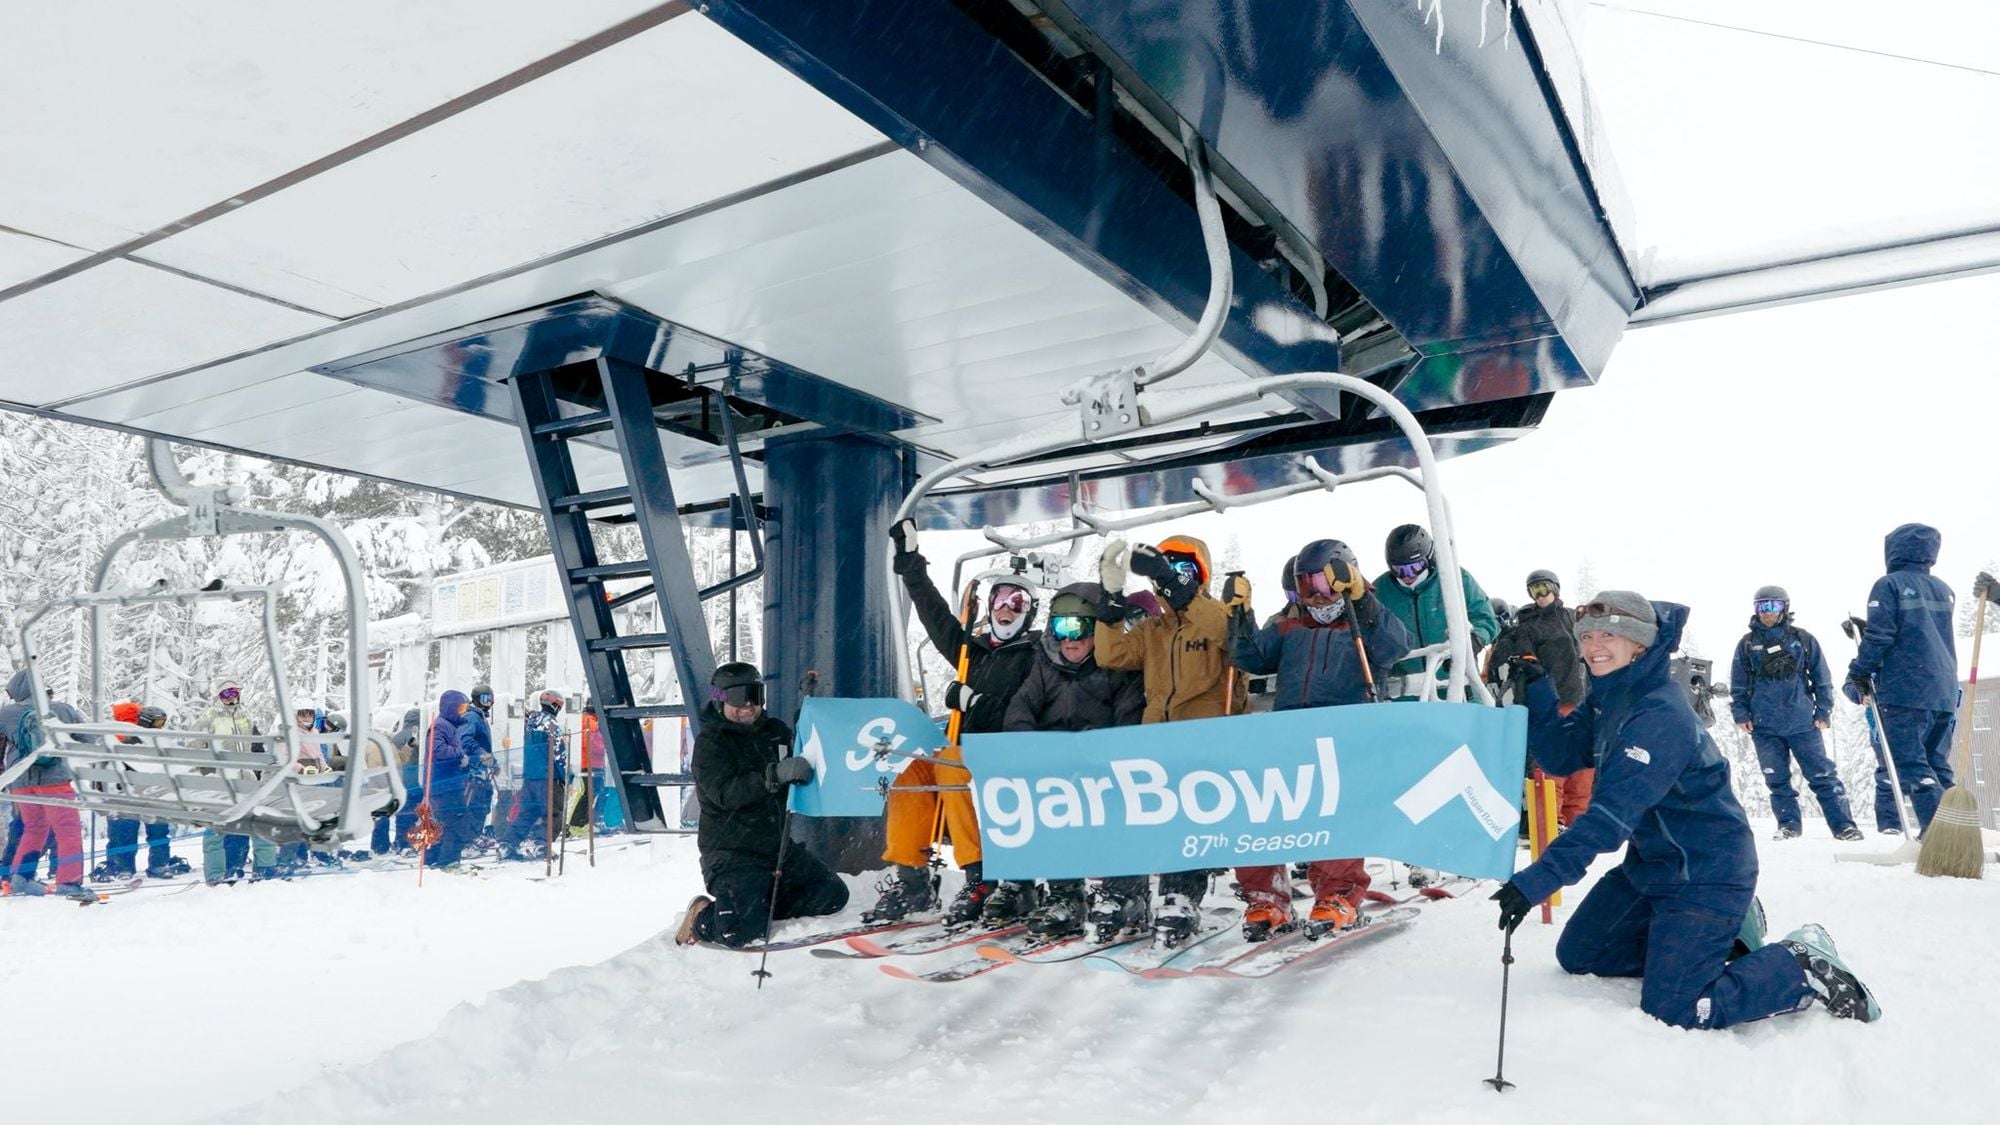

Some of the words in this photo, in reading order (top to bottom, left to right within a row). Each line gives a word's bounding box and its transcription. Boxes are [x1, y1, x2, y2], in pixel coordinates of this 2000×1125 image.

[1185, 638, 1208, 652] HH
[1182, 833, 1229, 858] 87th
[1234, 830, 1330, 853] Season
